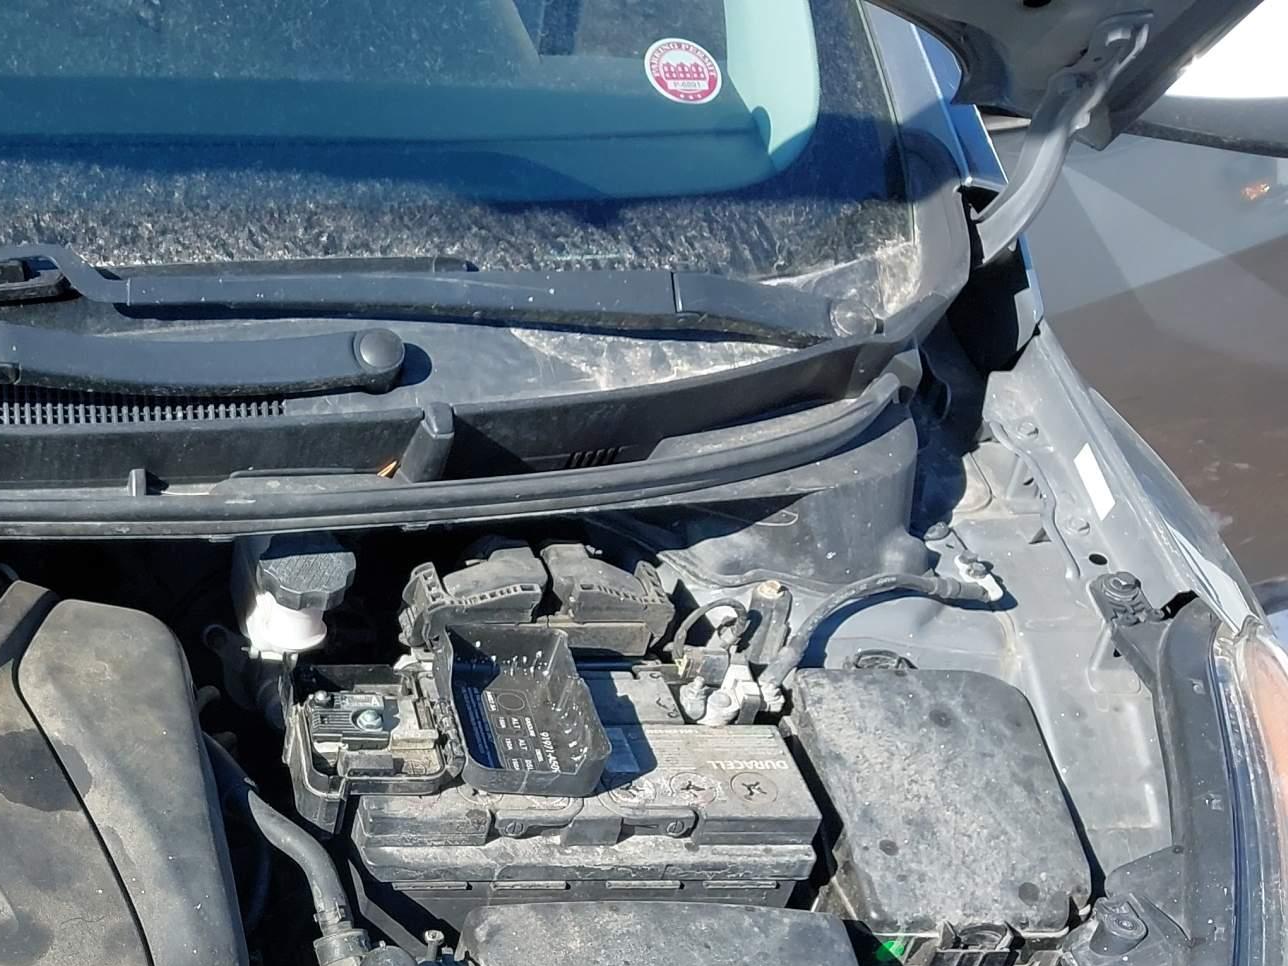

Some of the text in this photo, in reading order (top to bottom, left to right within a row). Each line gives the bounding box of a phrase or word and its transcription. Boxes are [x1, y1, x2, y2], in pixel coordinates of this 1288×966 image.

[650, 43, 678, 77] PARKING
[518, 738, 528, 751] ALT
[706, 759, 789, 770] DURACELL
